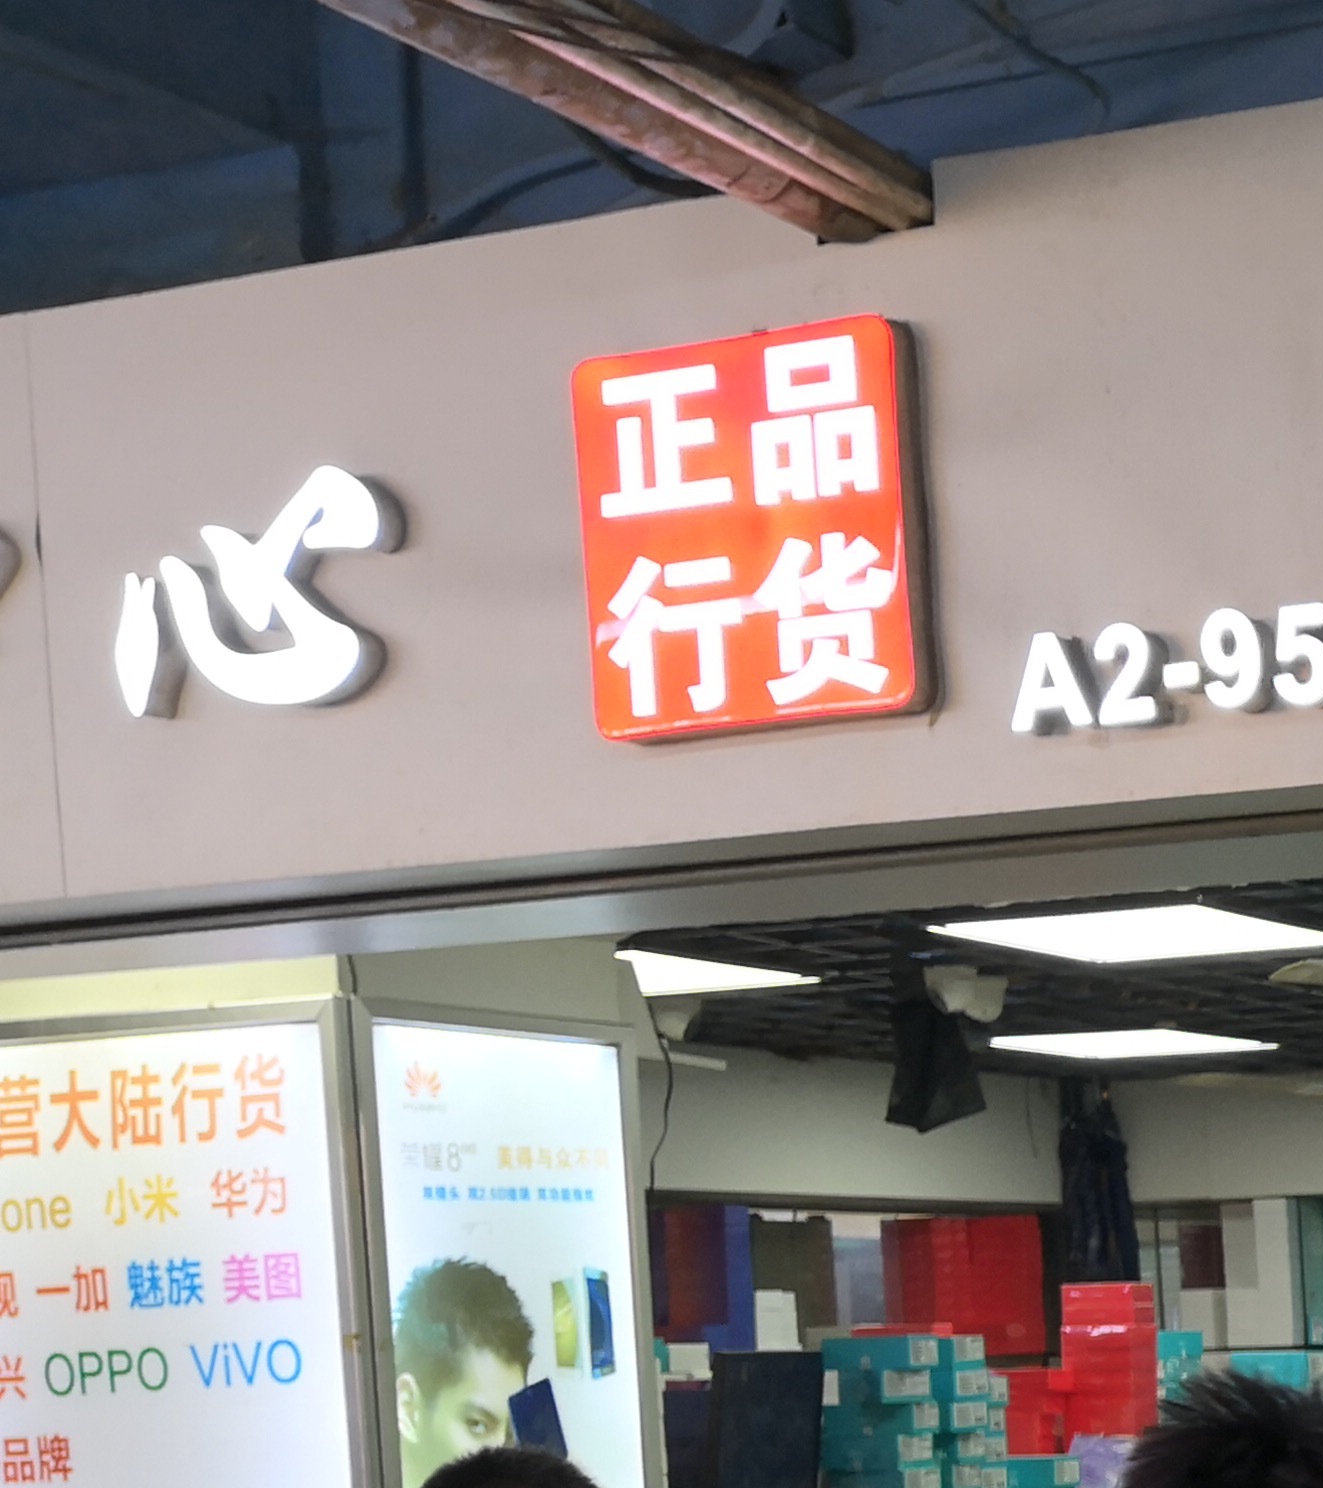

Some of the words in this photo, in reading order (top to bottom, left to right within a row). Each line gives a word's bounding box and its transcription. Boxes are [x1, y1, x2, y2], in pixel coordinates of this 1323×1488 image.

[597, 332, 882, 520] 正品
[113, 462, 384, 720] 心
[604, 530, 898, 718] 行货
[0, 1053, 288, 1159] 营大陆行货
[0, 1192, 73, 1234] one
[105, 1173, 181, 1227] 小米
[210, 1168, 288, 1220] 华为
[36, 1264, 110, 1313] 一加
[127, 1257, 206, 1310] 魅族
[223, 1252, 303, 1304] 美图
[44, 1346, 169, 1398] OPPO
[188, 1338, 304, 1390] ViVO
[2, 1433, 75, 1485] 品牌
